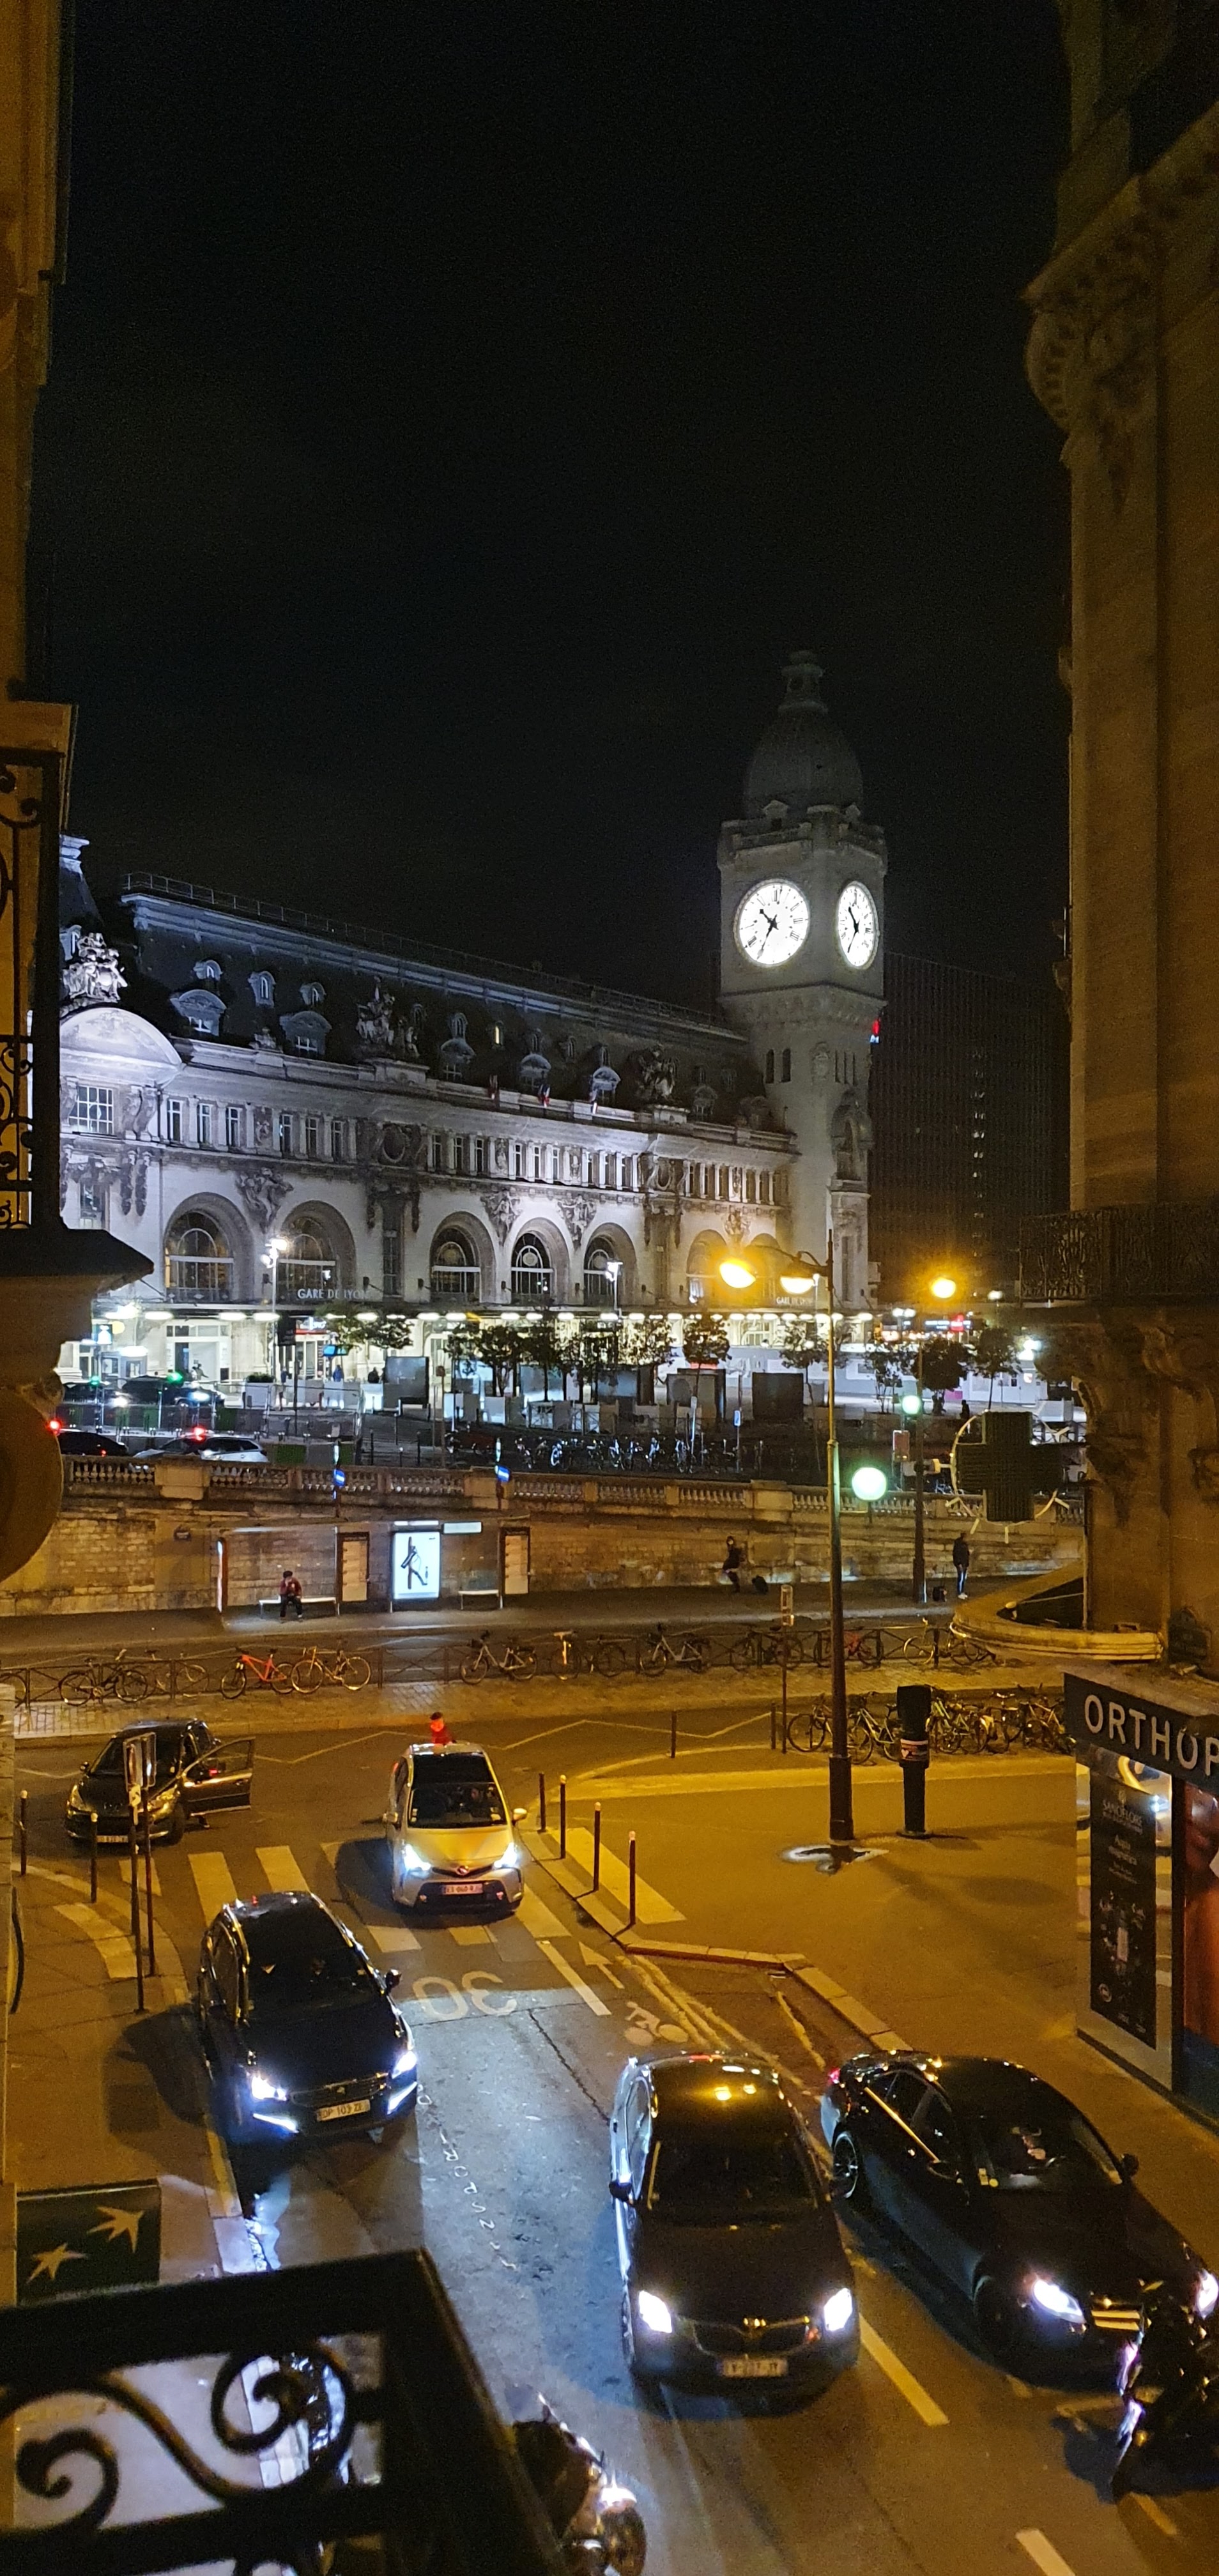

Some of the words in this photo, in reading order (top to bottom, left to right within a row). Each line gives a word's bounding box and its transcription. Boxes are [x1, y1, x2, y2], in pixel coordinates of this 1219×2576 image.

[297, 1288, 325, 1299] GARE
[1084, 1694, 1219, 1776] ORTHOP
[412, 1970, 518, 2021] 30
